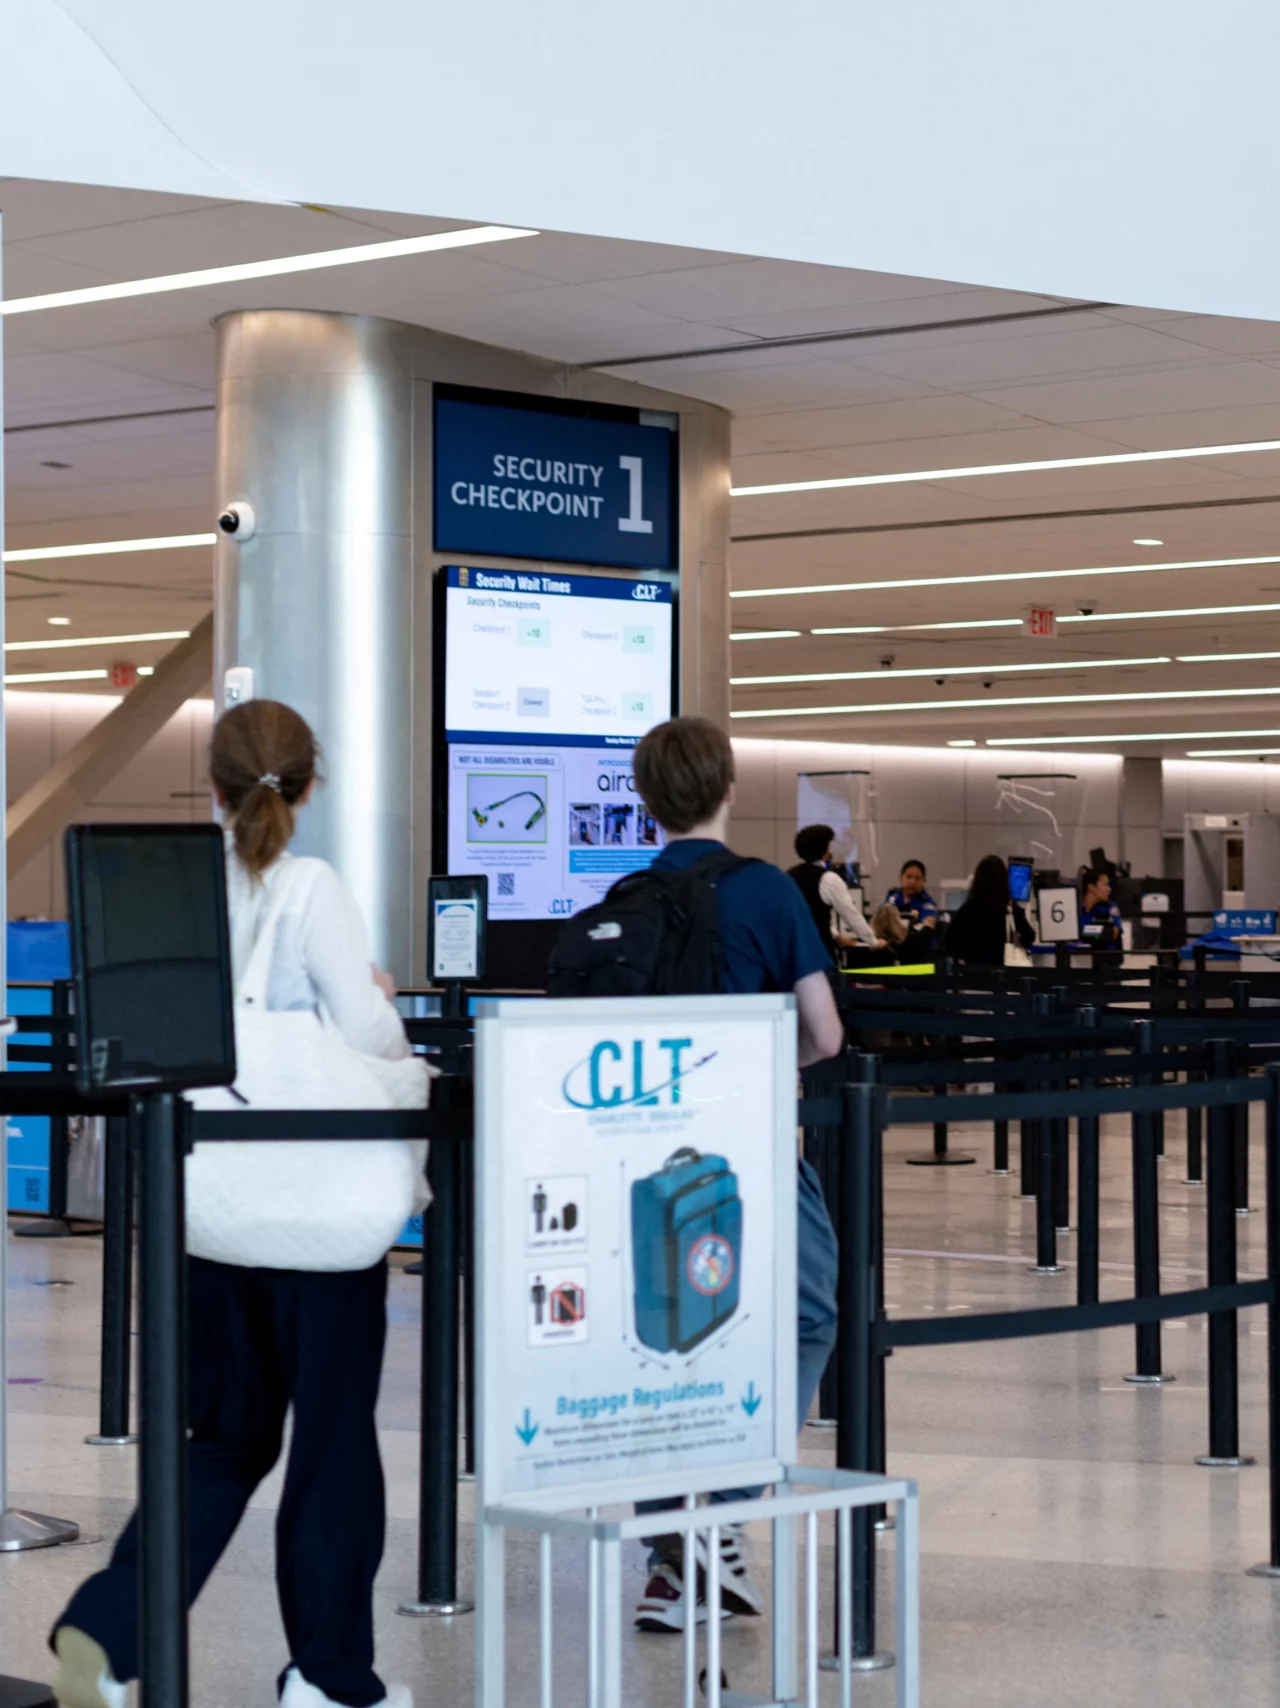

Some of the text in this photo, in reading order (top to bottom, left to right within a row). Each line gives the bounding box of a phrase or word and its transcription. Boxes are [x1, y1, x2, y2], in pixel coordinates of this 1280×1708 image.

[493, 454, 604, 488] SECURITY
[451, 481, 604, 519] CHECKPOINT
[618, 455, 653, 534] 1
[476, 572, 571, 594] Security Wait Times
[633, 583, 659, 600] CLT
[467, 596, 542, 611] Security Checkpoints
[1032, 608, 1054, 636] EXIT
[550, 899, 574, 914] CLT
[1051, 901, 1066, 924] 6
[588, 1037, 693, 1109] CLT
[556, 1394, 628, 1419] Baggage
[633, 1380, 724, 1411] Regulations
